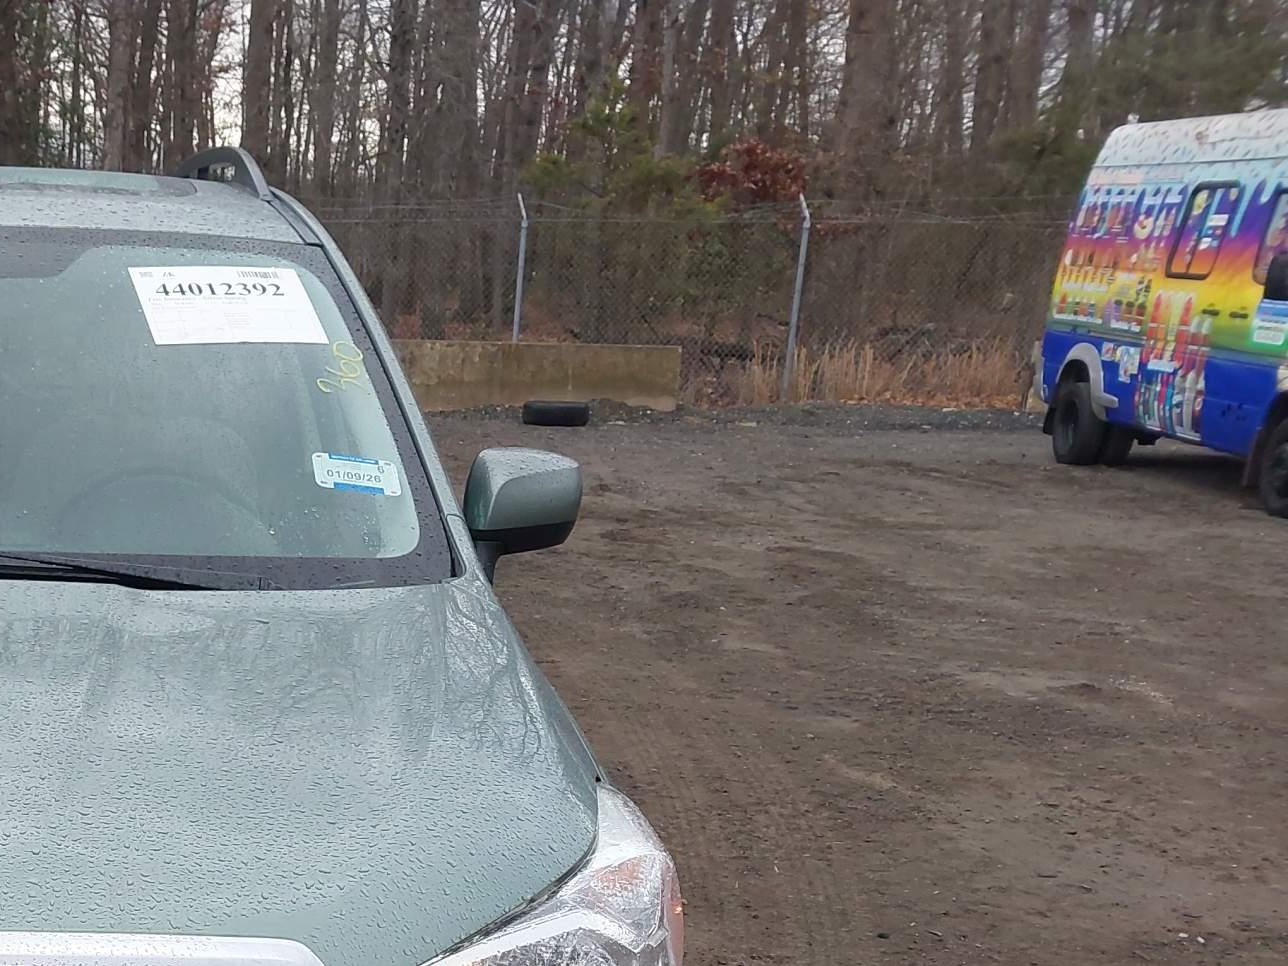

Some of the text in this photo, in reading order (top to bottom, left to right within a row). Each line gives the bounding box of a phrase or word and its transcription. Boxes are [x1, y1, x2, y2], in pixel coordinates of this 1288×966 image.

[155, 282, 285, 296] 44012392
[317, 340, 363, 393] 360
[326, 469, 381, 483] 01/09/26
